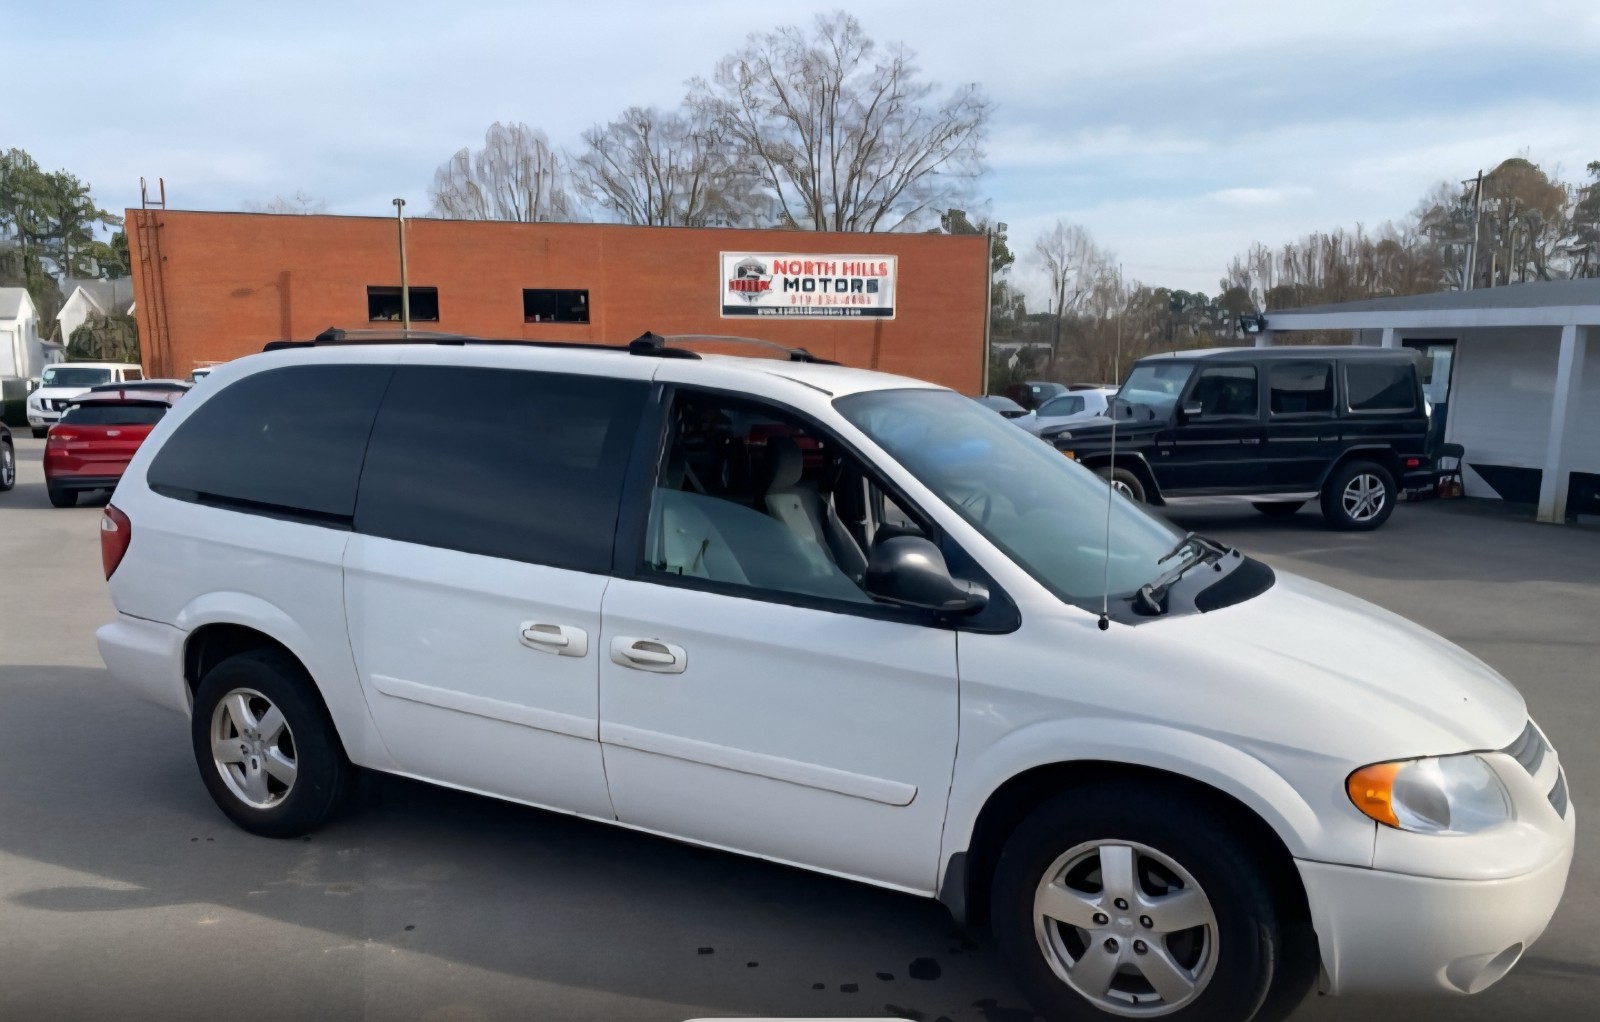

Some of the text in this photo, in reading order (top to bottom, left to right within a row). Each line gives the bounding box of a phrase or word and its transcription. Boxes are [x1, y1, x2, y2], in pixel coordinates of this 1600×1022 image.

[773, 260, 888, 277] NORTH HILLS
[783, 277, 879, 293] MOTORS
